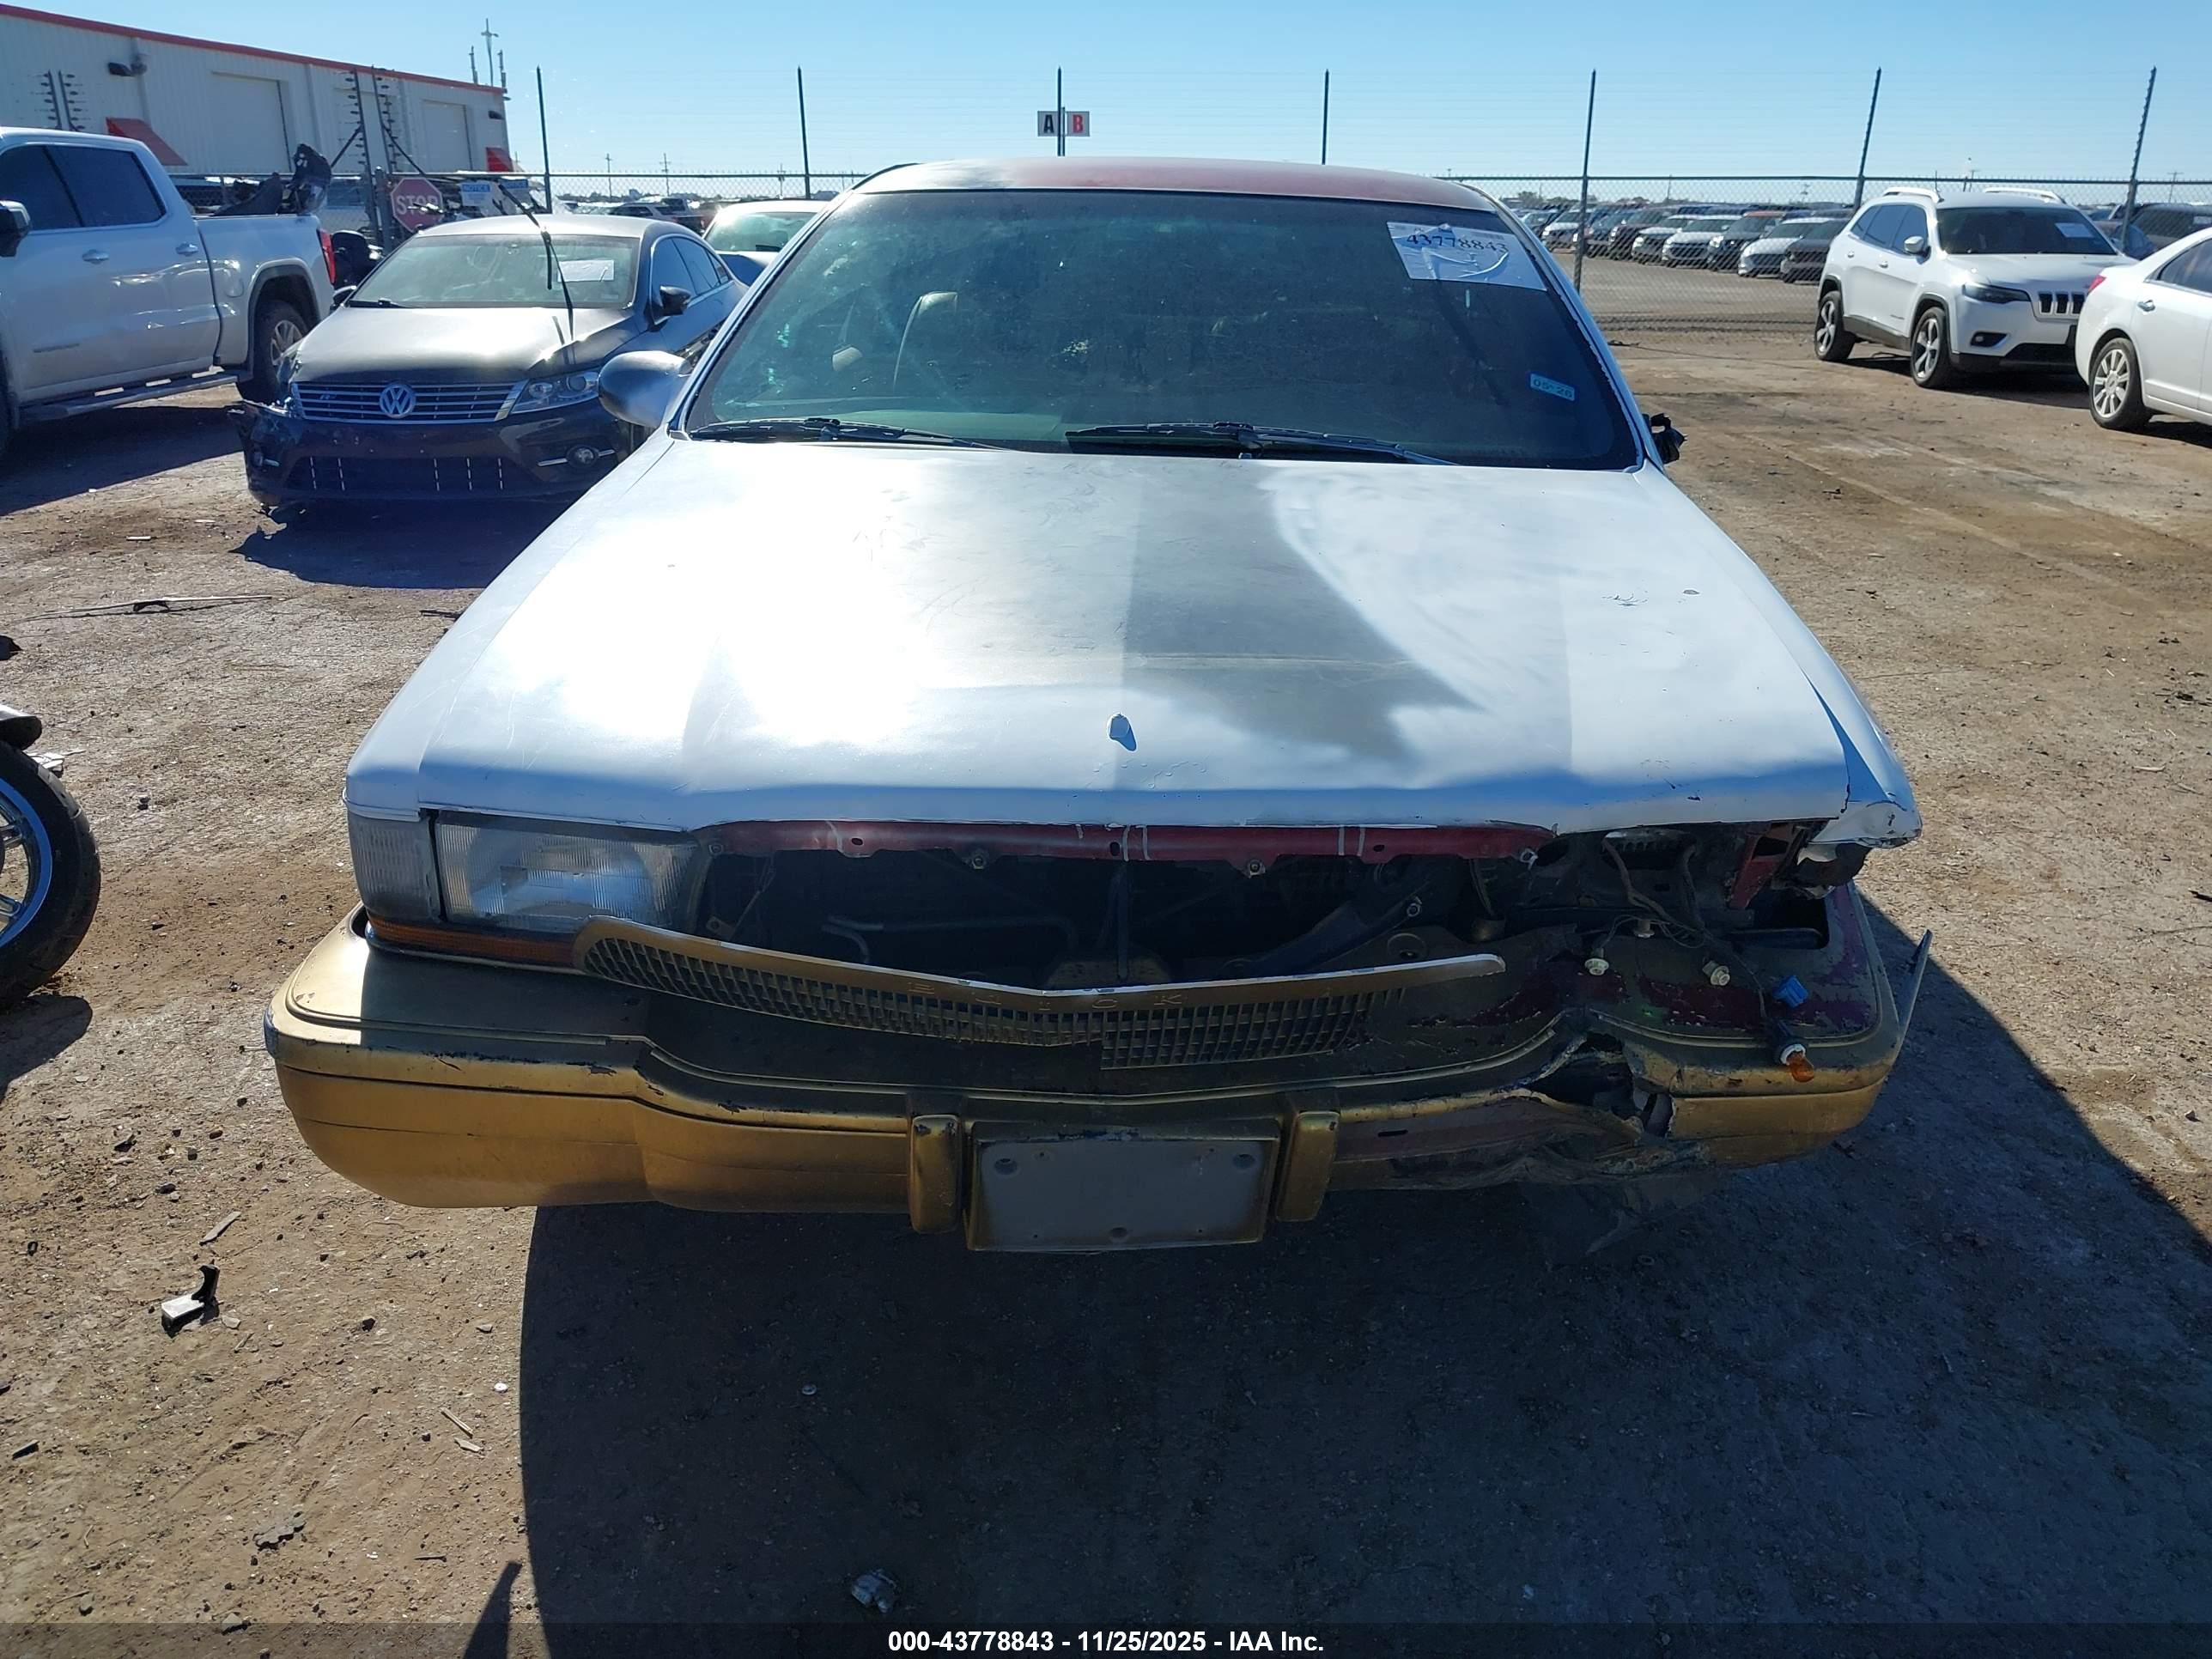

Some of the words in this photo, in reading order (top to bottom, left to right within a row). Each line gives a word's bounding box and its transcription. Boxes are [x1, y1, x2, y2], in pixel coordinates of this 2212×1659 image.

[1043, 114, 1054, 133] A
[1073, 114, 1084, 133] B
[396, 194, 439, 216] STOP
[1407, 234, 1509, 252] 43778843
